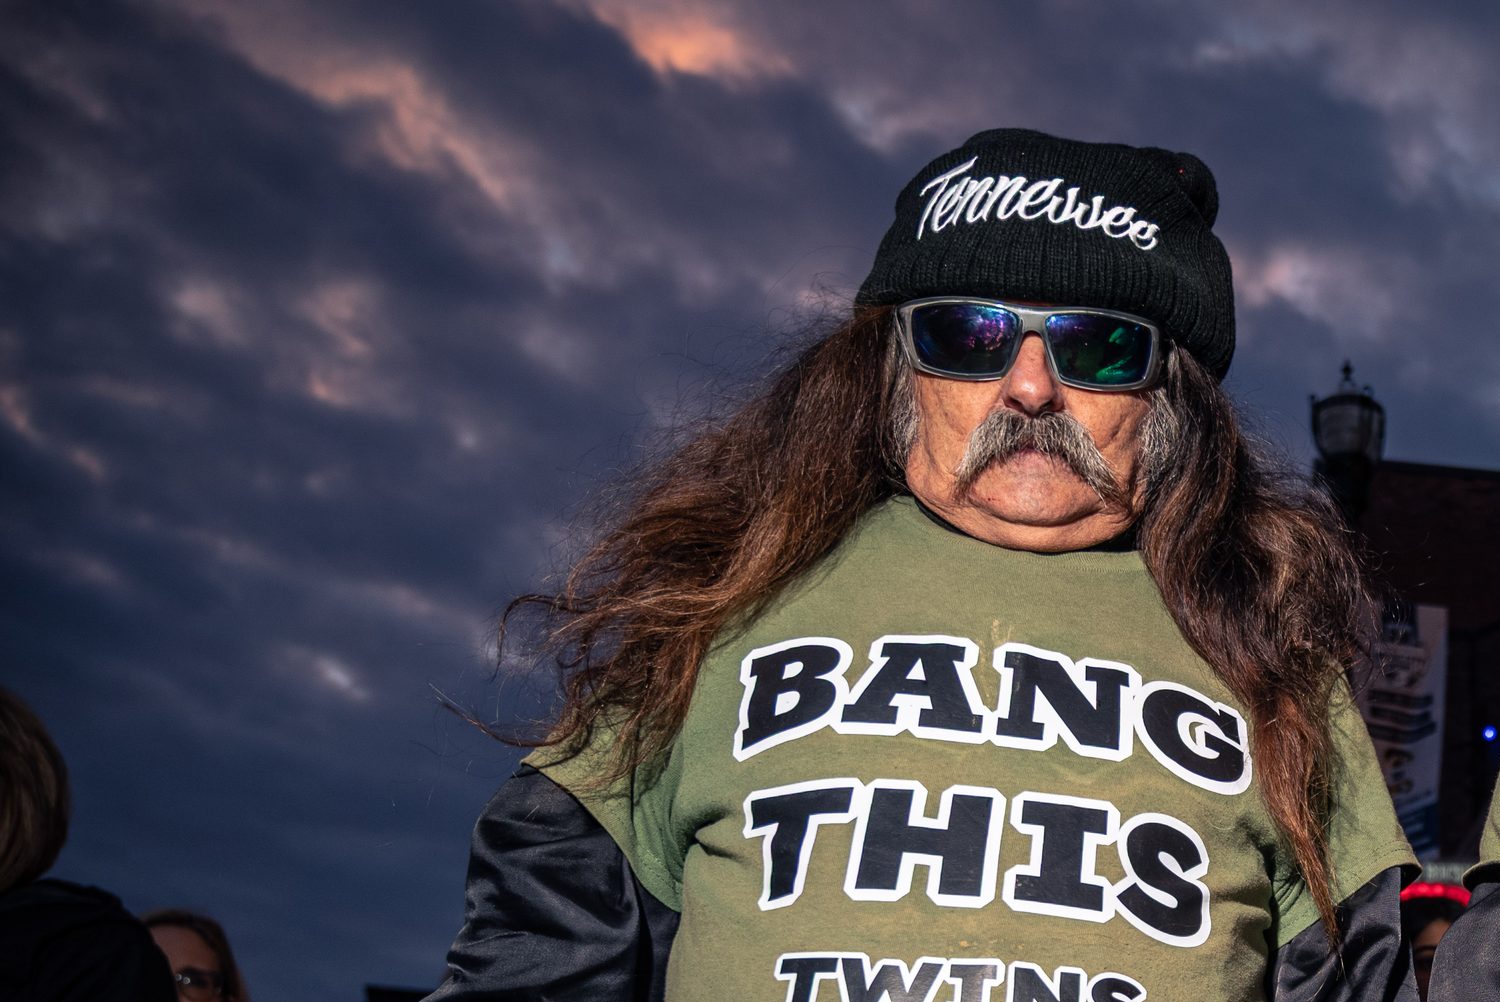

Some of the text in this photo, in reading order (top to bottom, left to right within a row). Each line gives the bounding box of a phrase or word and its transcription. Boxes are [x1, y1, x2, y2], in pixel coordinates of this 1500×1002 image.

[917, 155, 1160, 250] Tennessee
[733, 635, 1252, 795] BANG
[743, 778, 1211, 948] THIS
